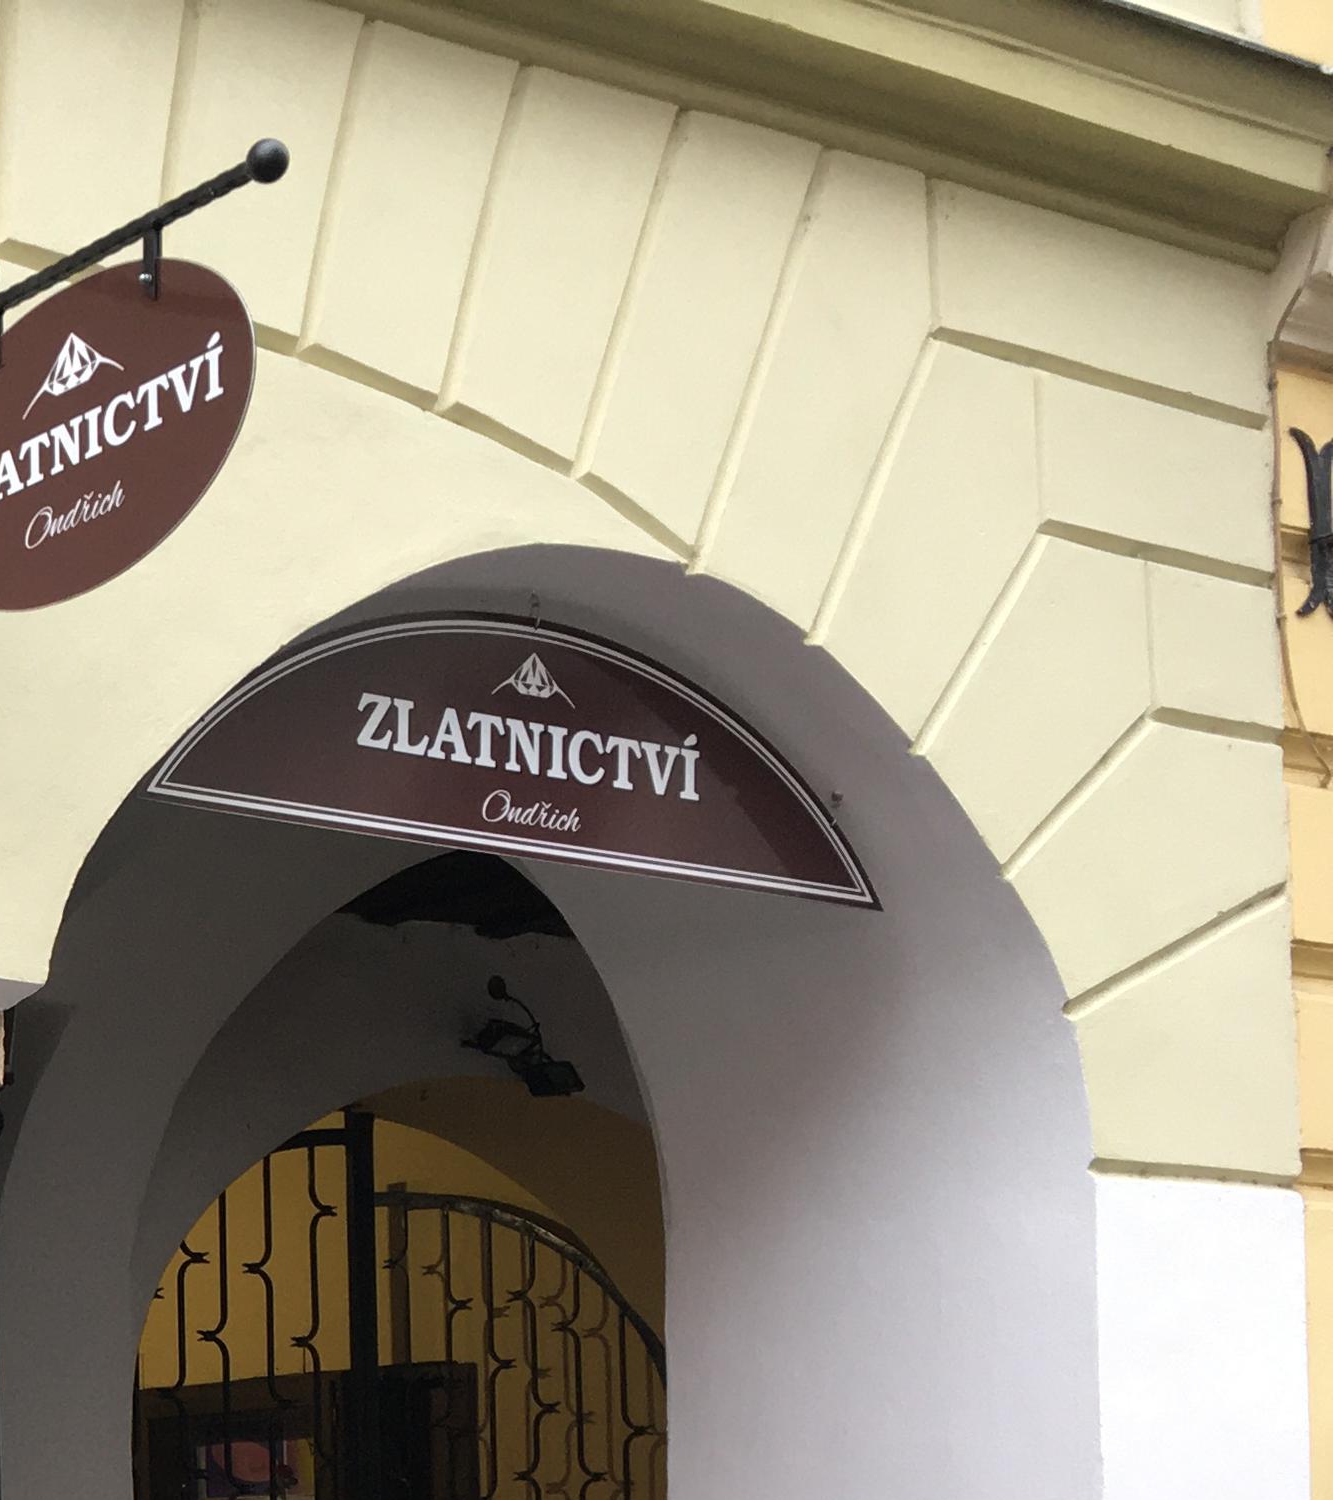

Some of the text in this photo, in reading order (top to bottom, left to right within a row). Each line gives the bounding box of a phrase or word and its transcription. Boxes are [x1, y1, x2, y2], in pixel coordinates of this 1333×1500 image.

[24, 479, 125, 550] Ondřich
[355, 692, 701, 802] ZLATNICTVÍ
[481, 789, 582, 833] Ondřich
